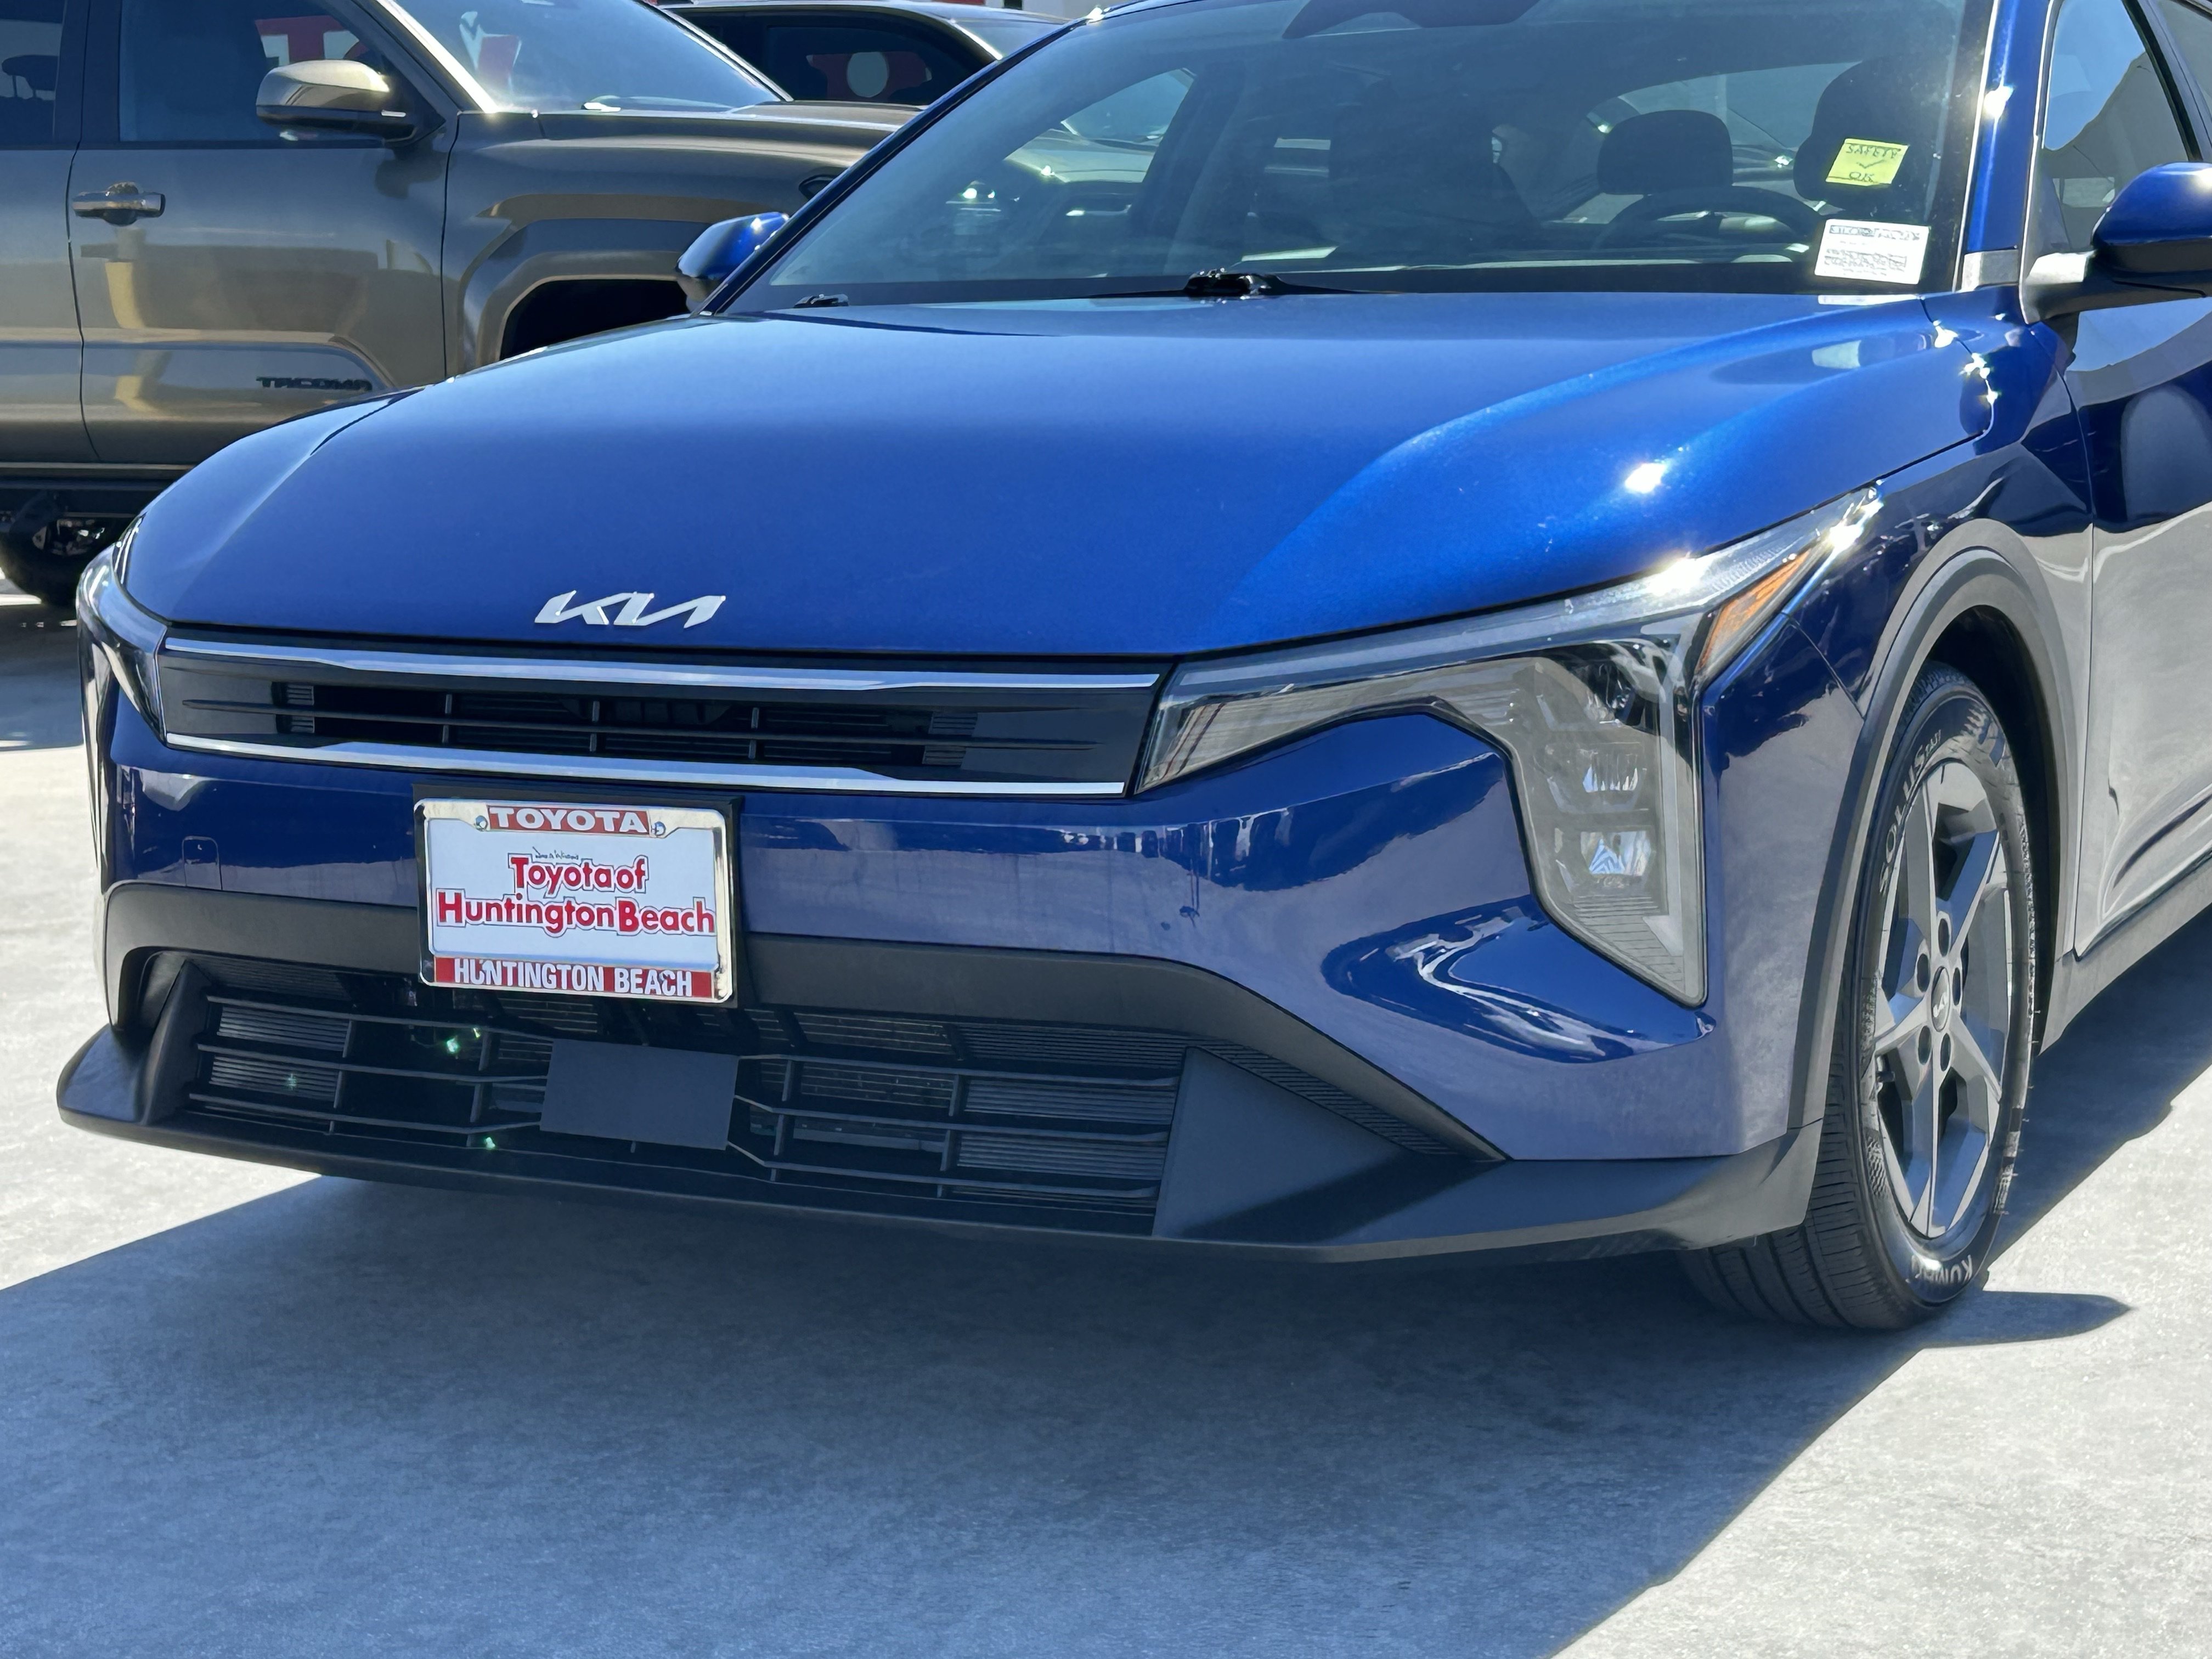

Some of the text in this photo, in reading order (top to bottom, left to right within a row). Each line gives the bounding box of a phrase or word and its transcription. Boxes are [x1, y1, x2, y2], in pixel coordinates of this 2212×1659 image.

[256, 376, 373, 391] TACOMA
[534, 590, 726, 629] KIA
[489, 807, 647, 833] TOYOTA
[510, 855, 646, 894] Toyota of
[438, 891, 715, 934] Huntington Beach
[454, 958, 692, 997] HUNTINGTON BEACH
